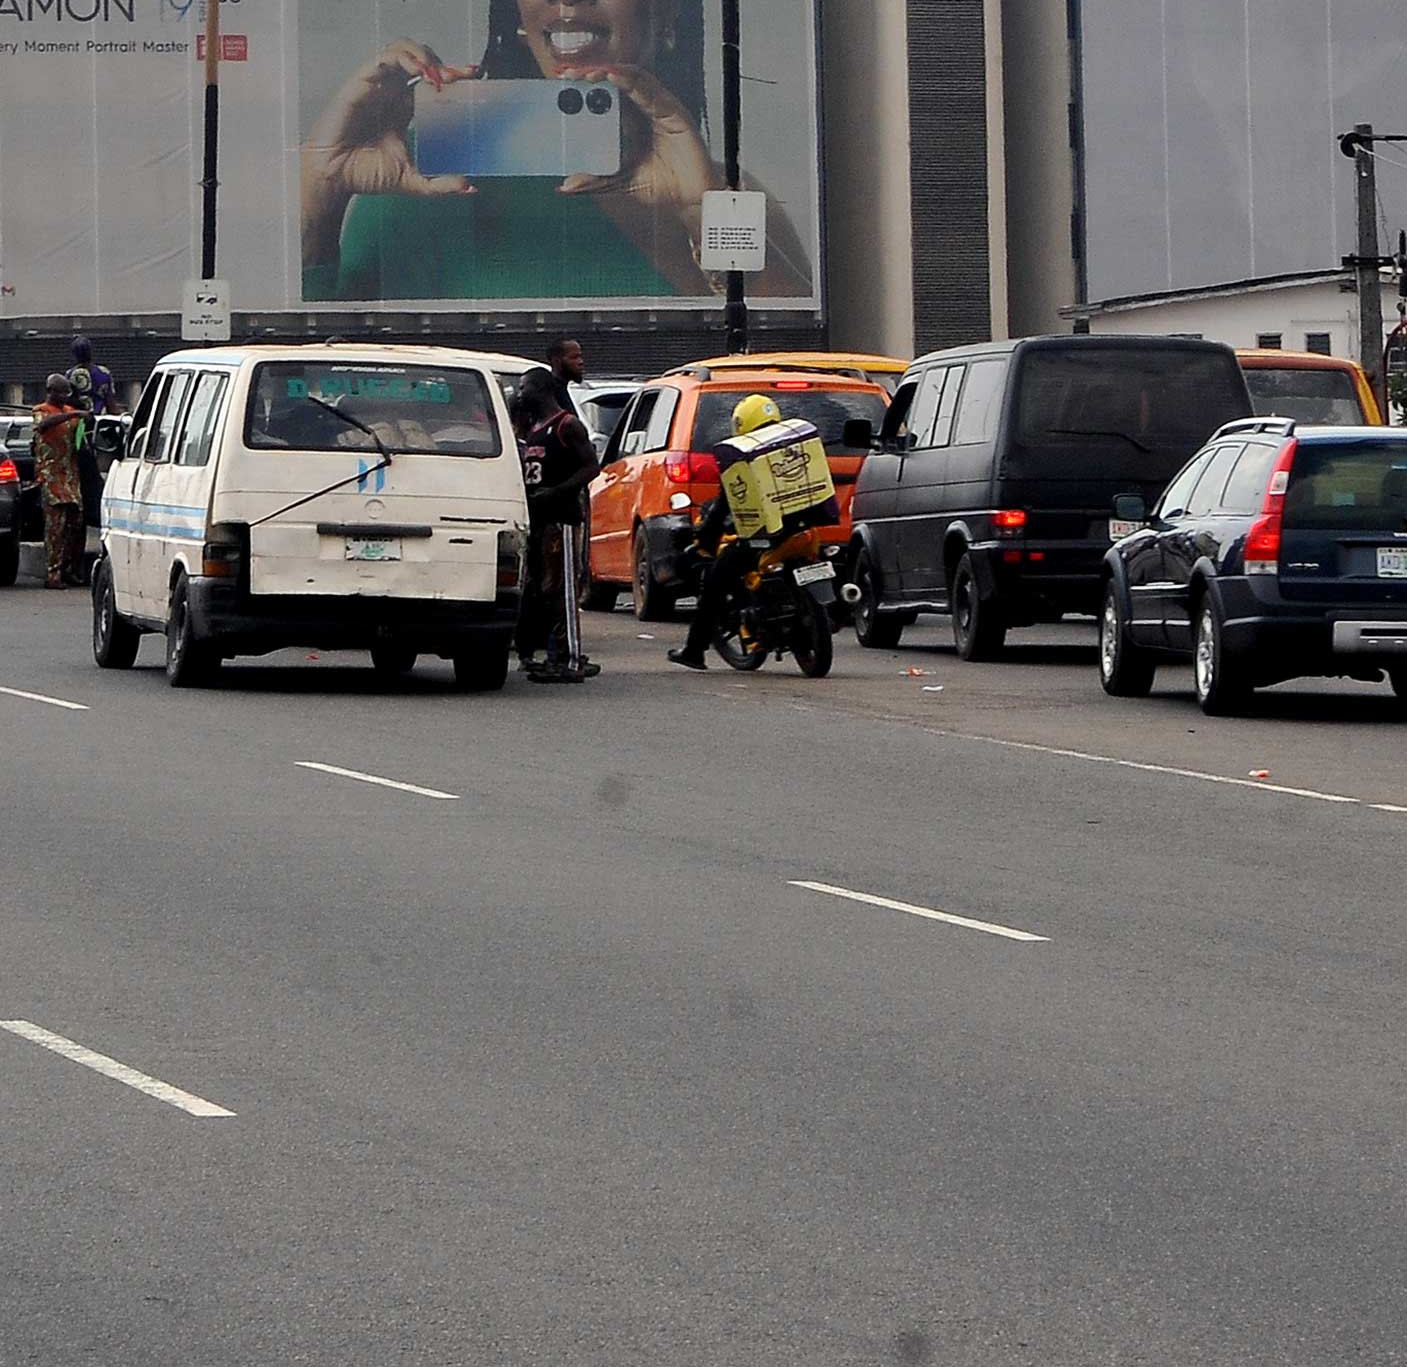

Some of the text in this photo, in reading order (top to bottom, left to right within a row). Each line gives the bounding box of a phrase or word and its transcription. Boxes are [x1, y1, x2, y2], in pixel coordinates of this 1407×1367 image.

[25, 40, 80, 54] Moment
[86, 40, 136, 53] Portrait
[143, 41, 189, 53] Master
